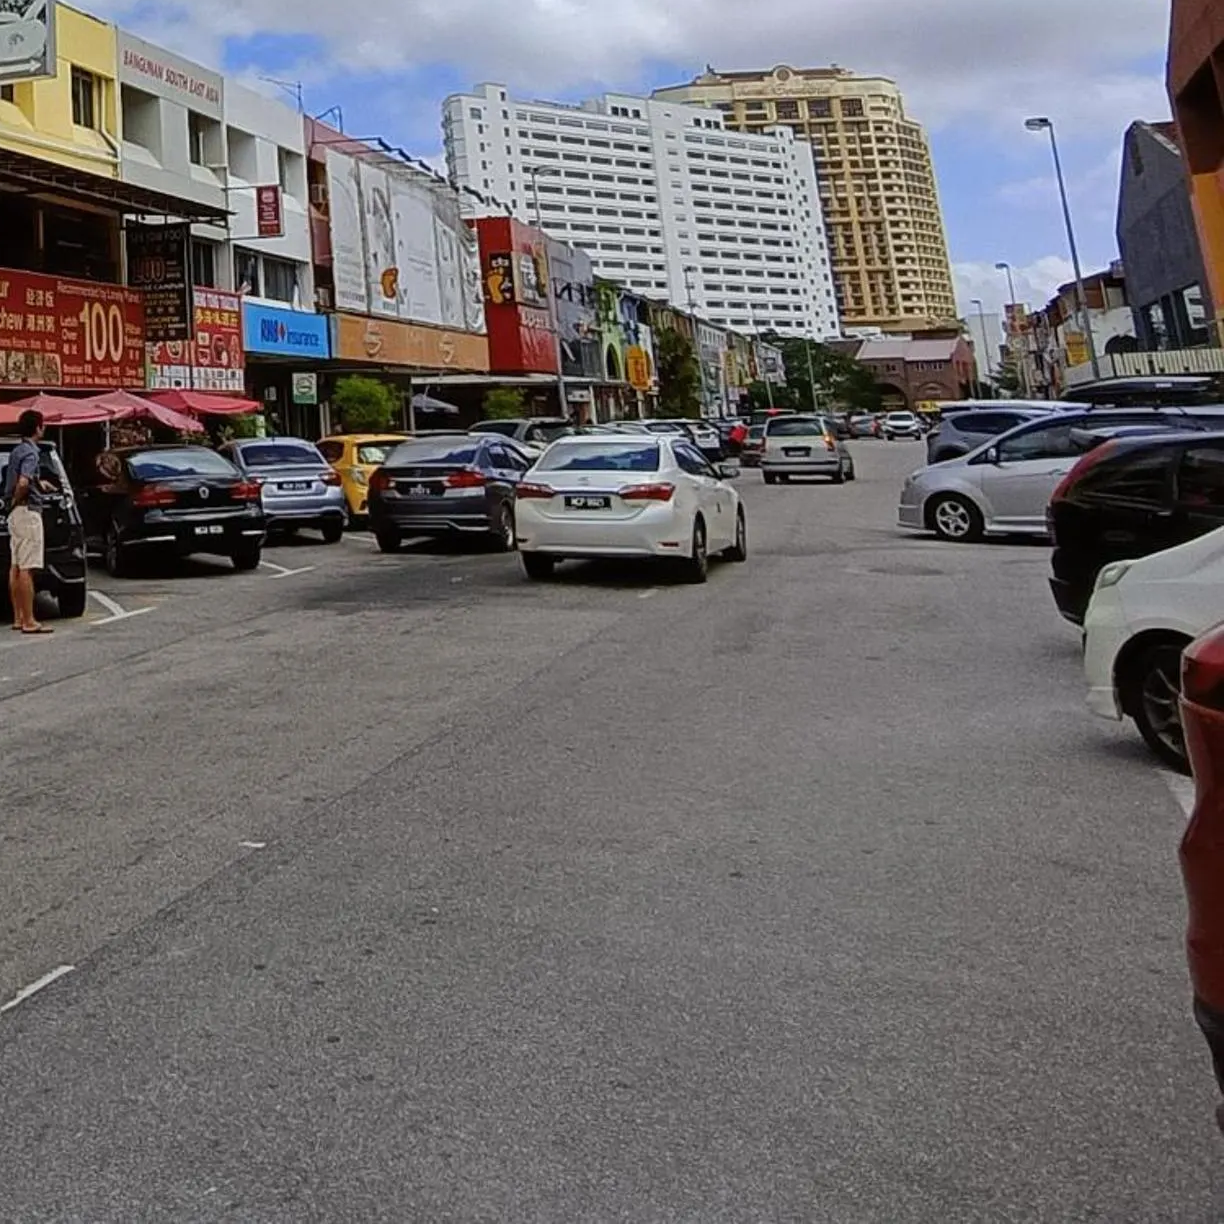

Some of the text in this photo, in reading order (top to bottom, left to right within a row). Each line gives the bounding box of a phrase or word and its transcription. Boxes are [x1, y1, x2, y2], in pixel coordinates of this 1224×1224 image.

[123, 49, 220, 103] BANGUNAN SOUTH EAST ASIA
[79, 301, 124, 364] 100
[260, 318, 278, 344] RHB
